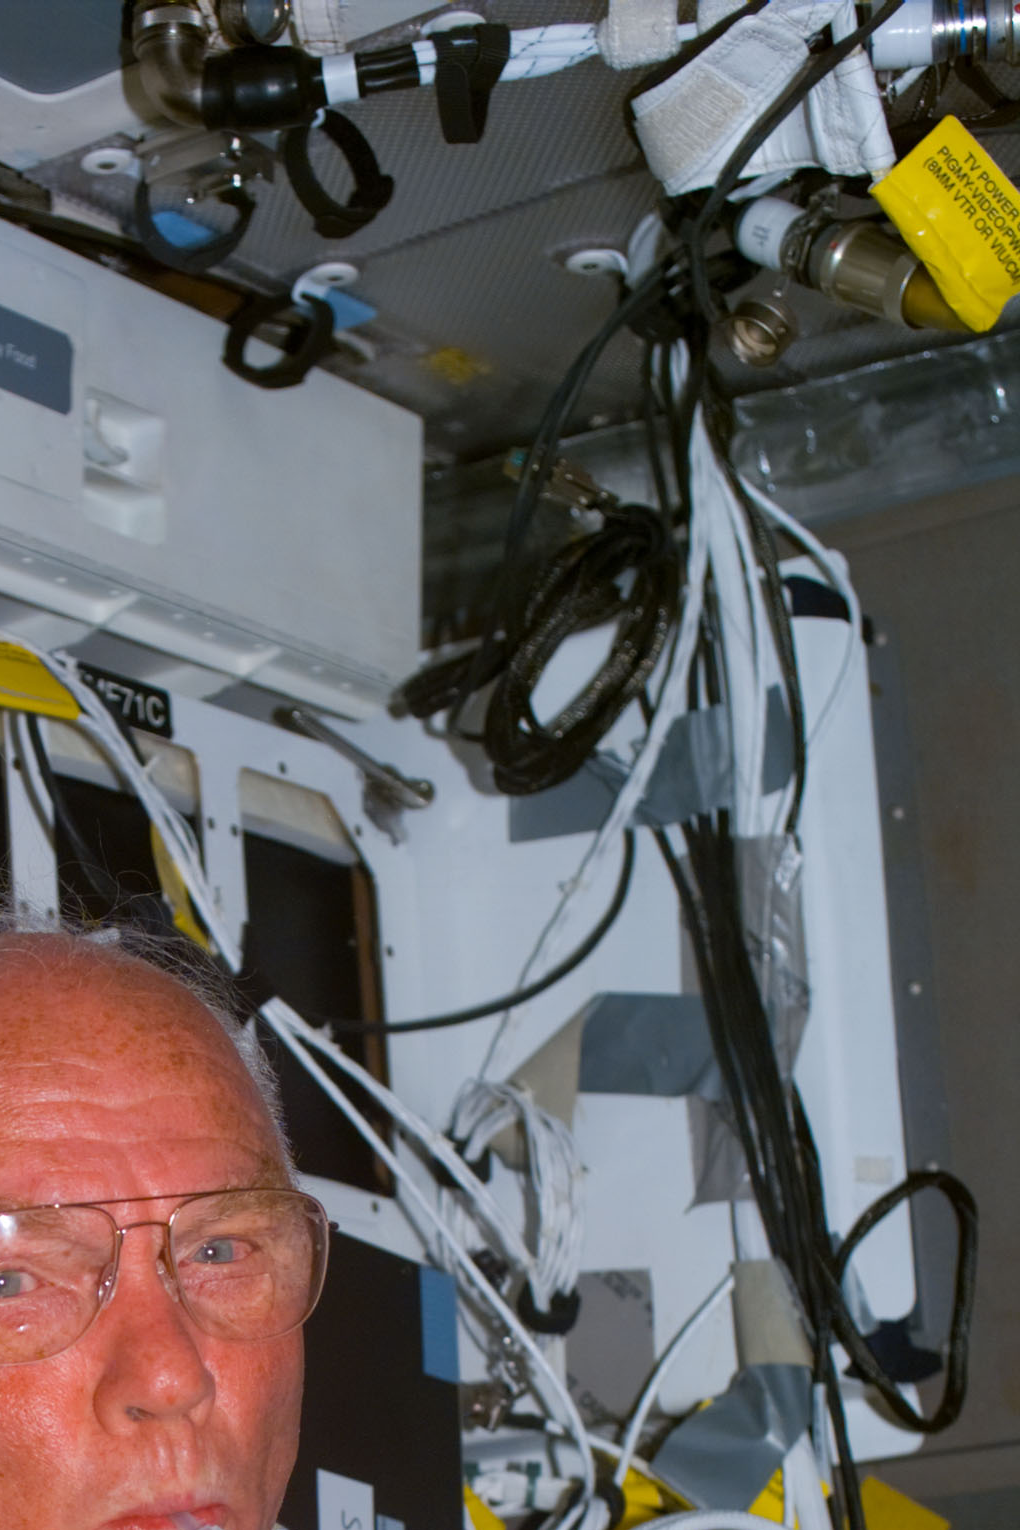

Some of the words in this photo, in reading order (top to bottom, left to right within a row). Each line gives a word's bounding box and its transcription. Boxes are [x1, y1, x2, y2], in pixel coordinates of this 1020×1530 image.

[923, 156, 956, 193] (8MM
[953, 188, 977, 220] VTR
[973, 217, 994, 241] OR
[937, 146, 1020, 254] PIGMY-VIDEO/PW
[964, 151, 981, 173] TV
[977, 171, 1020, 221] POWER
[5, 343, 37, 370] Food
